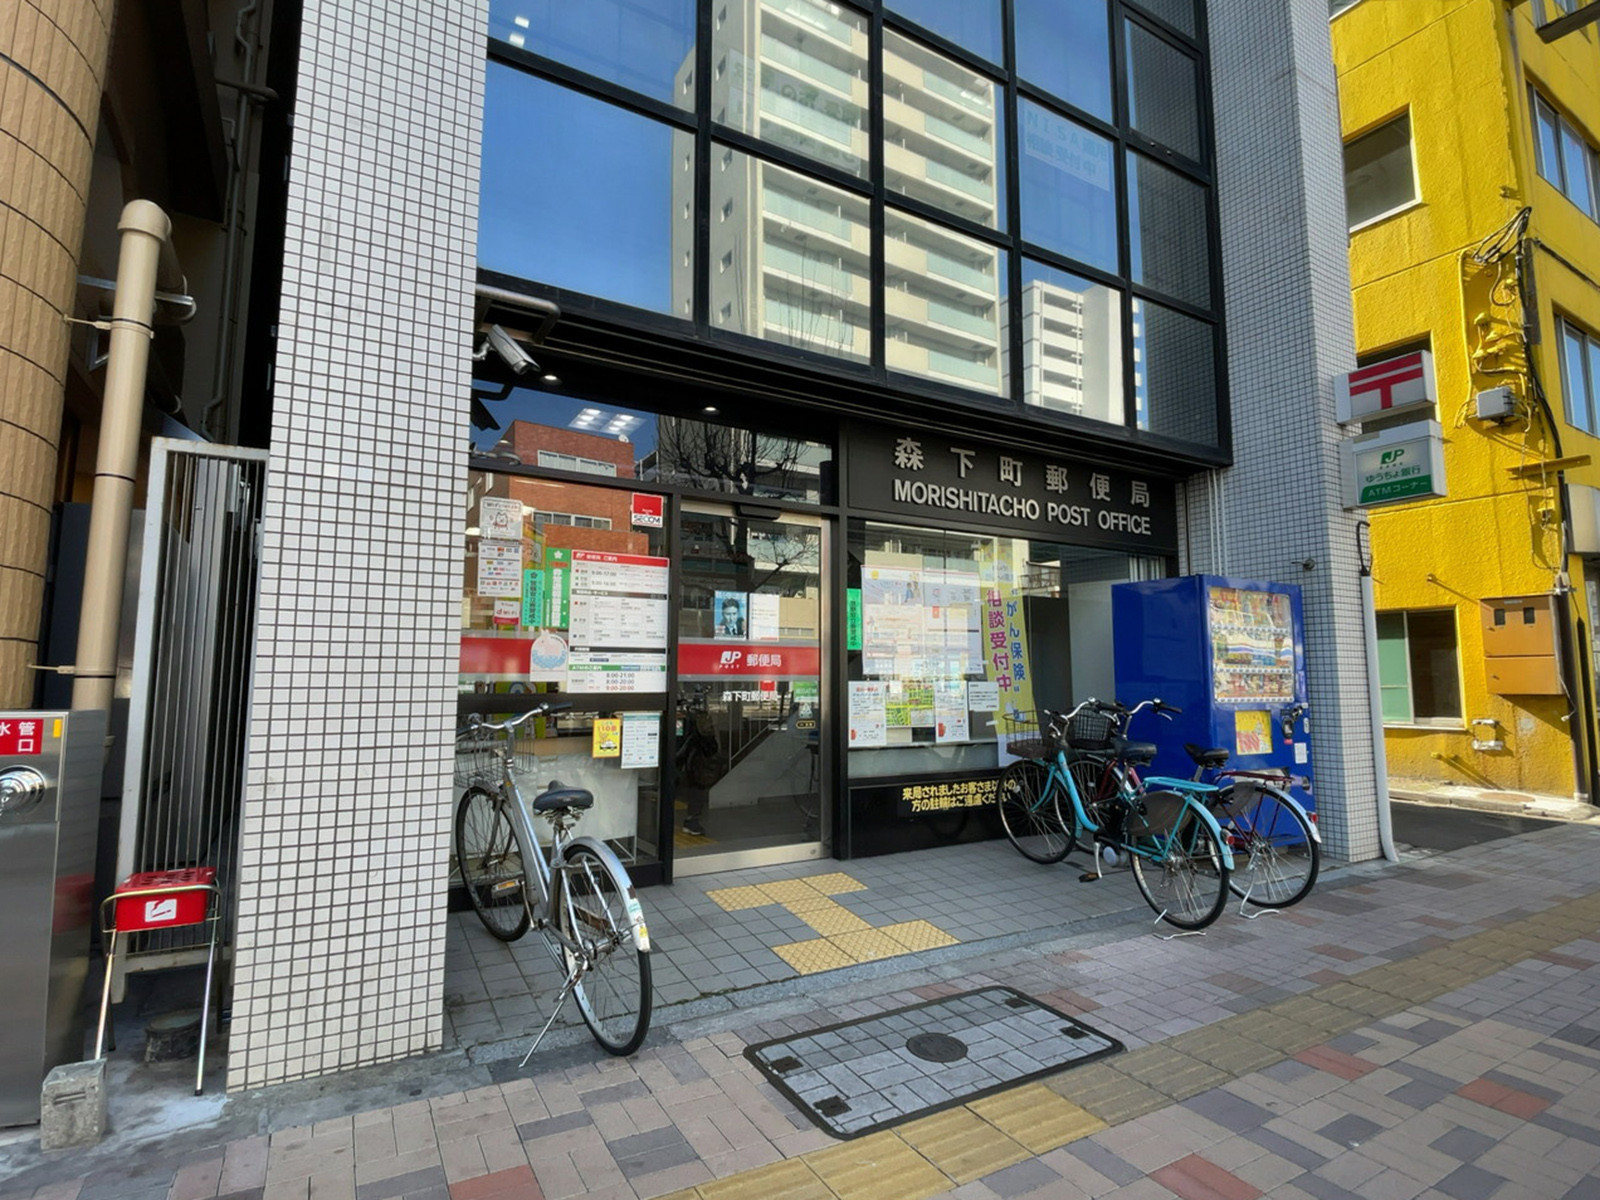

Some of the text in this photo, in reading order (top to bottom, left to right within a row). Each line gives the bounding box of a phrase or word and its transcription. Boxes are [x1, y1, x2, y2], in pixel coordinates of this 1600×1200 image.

[894, 437, 1150, 508] 森下町郵便局
[1366, 465, 1420, 482] ゆうちょ銀行
[1368, 481, 1428, 498] ATMコーナー
[894, 478, 1151, 535] MORISHITACHO POST OFFICE
[633, 514, 661, 523] SECOM
[987, 589, 1012, 693] 相談受付中
[746, 653, 782, 667] 郵便局
[722, 690, 778, 702] 森下町郵便局
[911, 792, 1011, 812] 方の駐輪はご遠慮くだい
